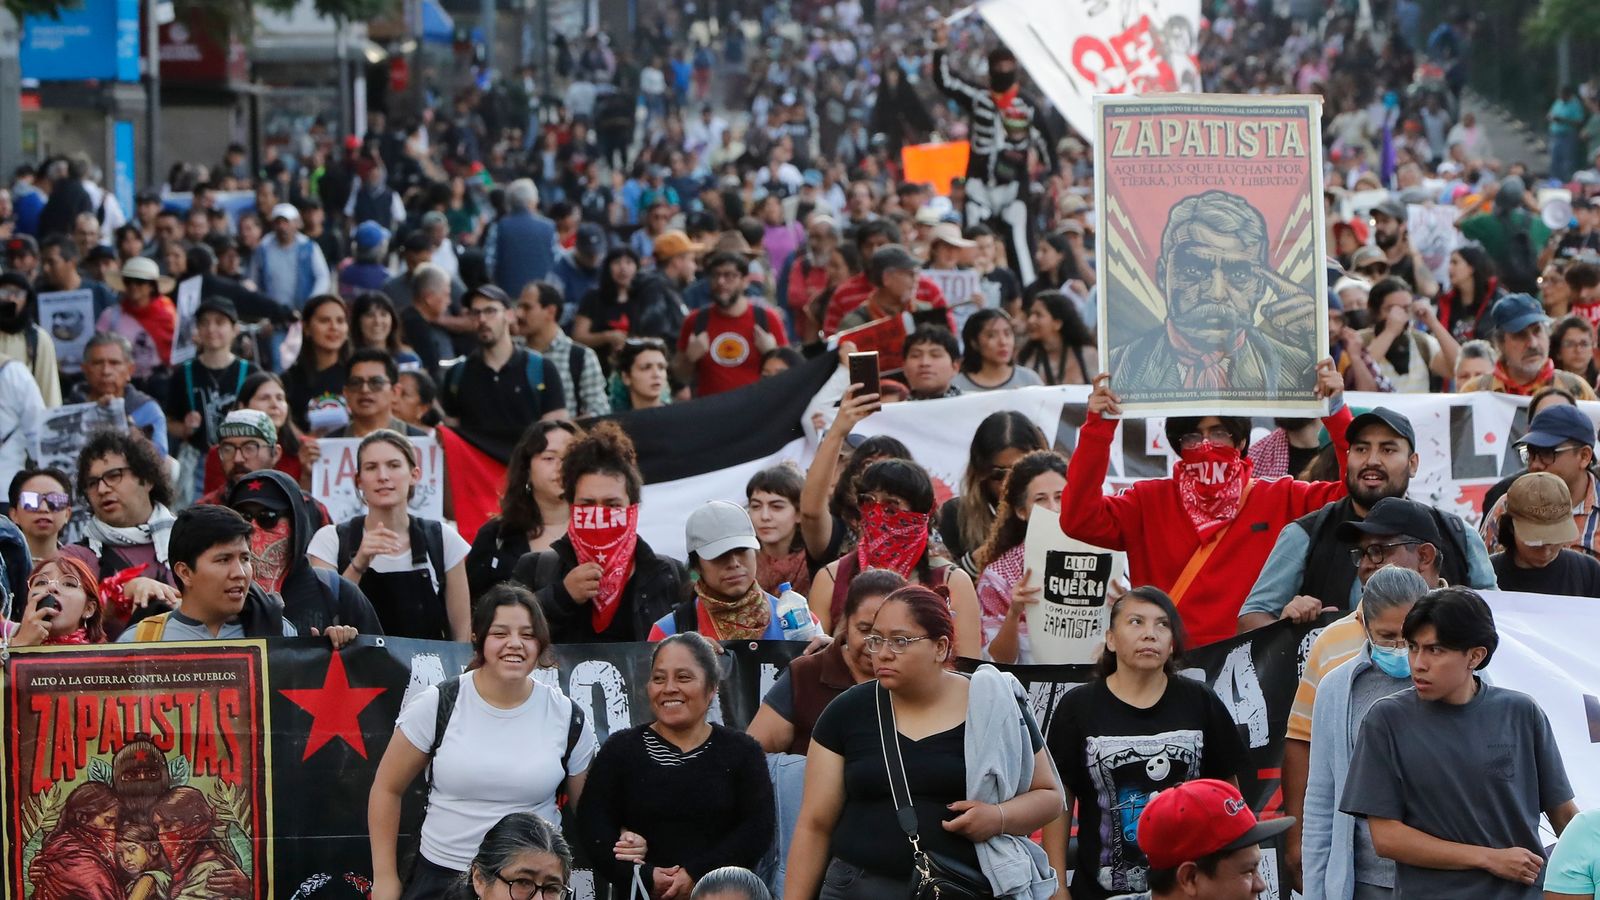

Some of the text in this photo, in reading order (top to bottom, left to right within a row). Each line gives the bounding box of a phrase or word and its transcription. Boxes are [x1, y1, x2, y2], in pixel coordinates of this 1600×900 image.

[1110, 119, 1305, 158] ZAPATISTA
[1114, 163, 1303, 176] AQUELLXS QUE LUCHAN POR
[1120, 176, 1298, 188] TIERRA, JUSTICIA Y LIBERTAD
[573, 506, 627, 529] EZLN
[1065, 557, 1096, 570] ALTO
[31, 677, 57, 686] ALTO
[68, 676, 81, 685] LA
[83, 675, 126, 684] GUERRA
[128, 674, 171, 683] CONTRA
[173, 673, 191, 682] LOS
[193, 672, 236, 681] PUEBLOS
[30, 688, 243, 794] ZAPATISTAS
